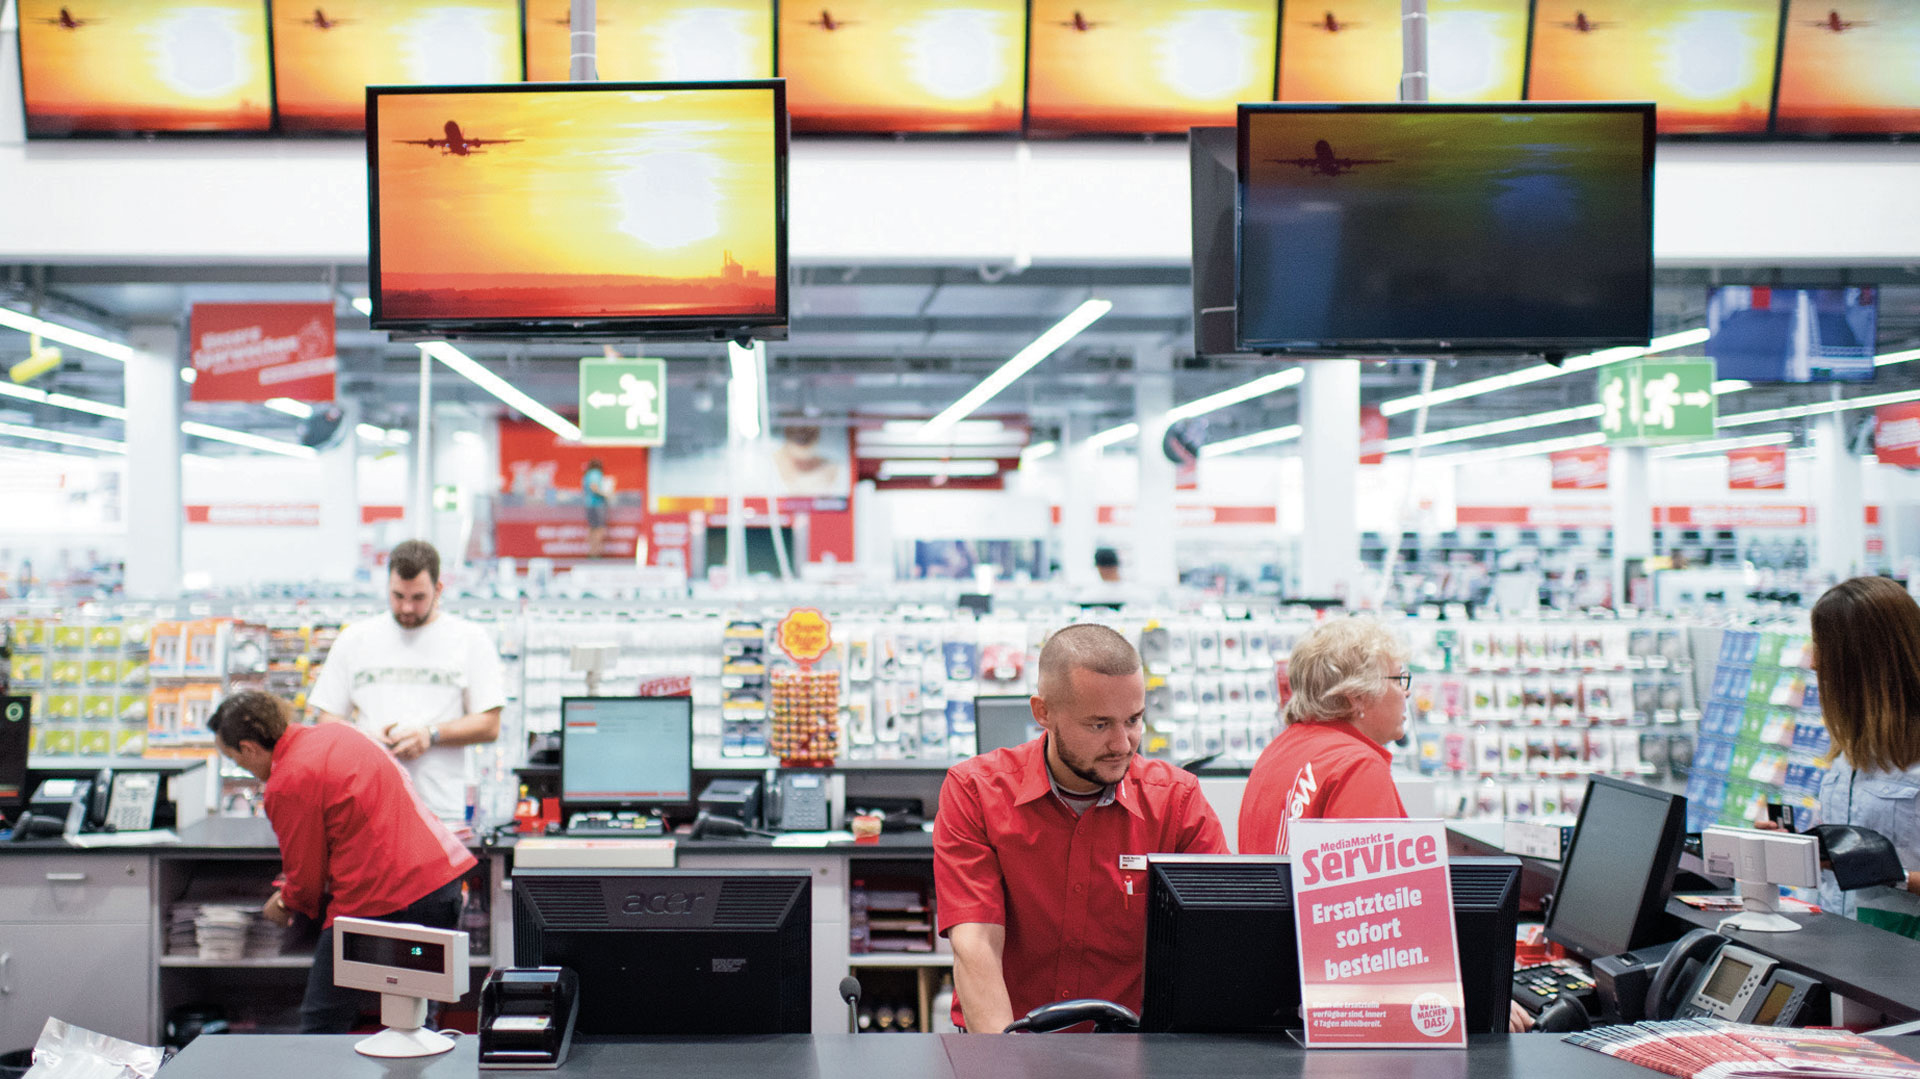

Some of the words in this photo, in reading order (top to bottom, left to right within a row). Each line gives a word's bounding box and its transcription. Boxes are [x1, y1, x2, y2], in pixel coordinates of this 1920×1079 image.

[1320, 833, 1382, 852] MediaMarkt
[1302, 833, 1437, 885] Service
[621, 892, 705, 915] acer
[1312, 886, 1422, 924] Ersatzteile
[1336, 917, 1402, 948] sofort
[1324, 946, 1429, 981] bestellen.
[1319, 1020, 1340, 1028] Tagen
[1417, 1007, 1447, 1020] MACHEN
[1424, 1016, 1446, 1029] DAS!
